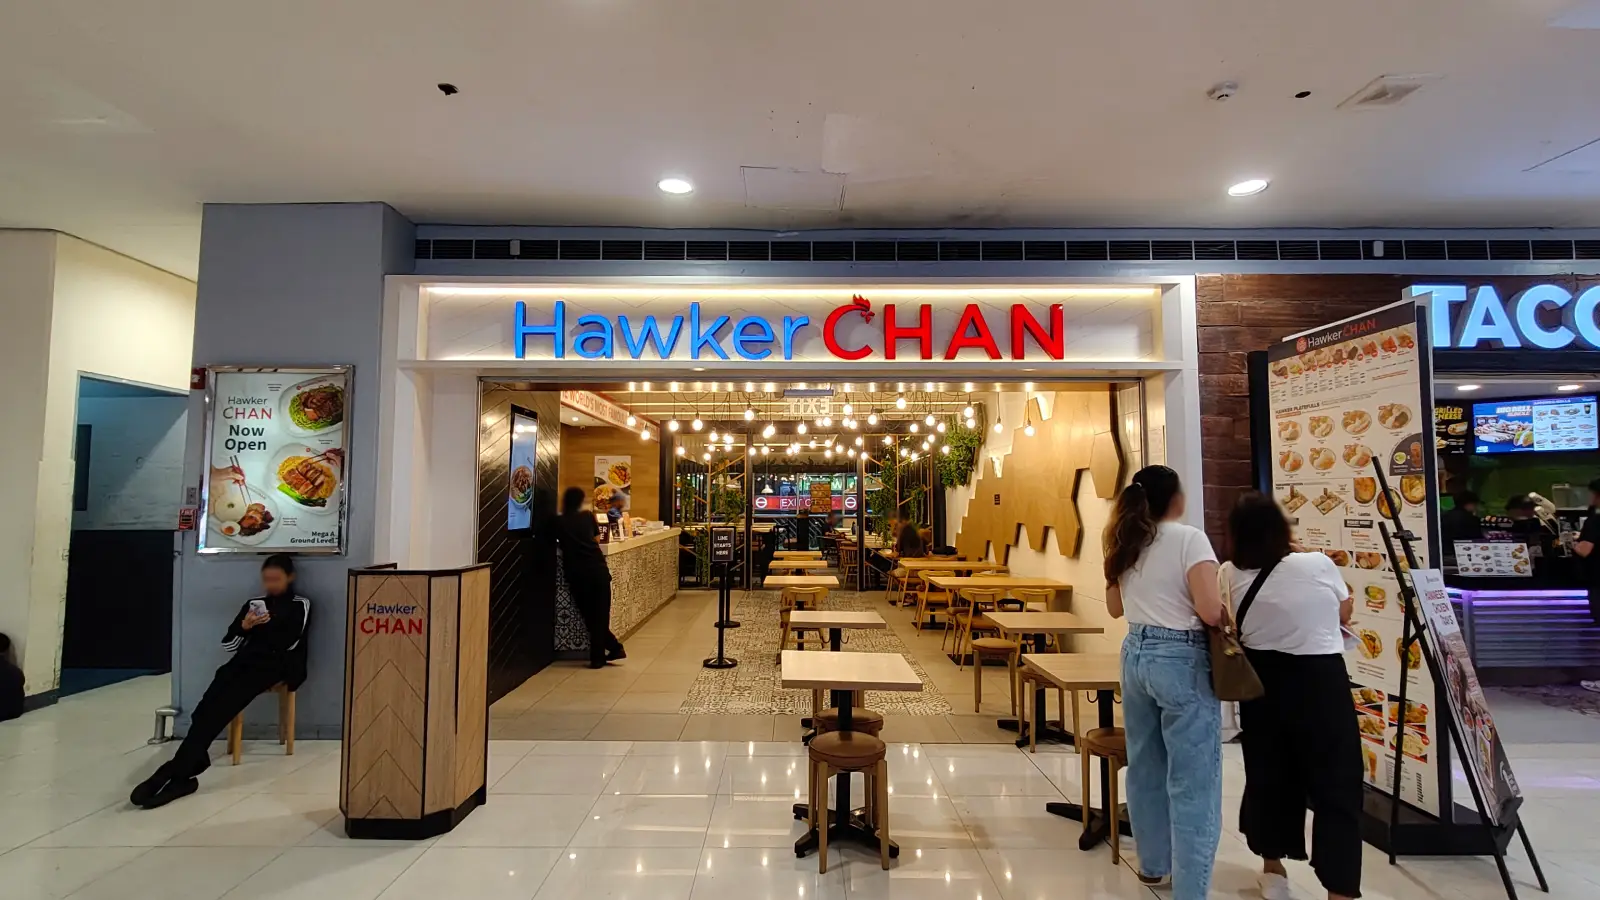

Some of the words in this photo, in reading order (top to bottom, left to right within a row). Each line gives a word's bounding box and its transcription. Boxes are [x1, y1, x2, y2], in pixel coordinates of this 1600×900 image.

[514, 300, 809, 361] Hawker
[822, 295, 1065, 361] CHAN
[1307, 330, 1343, 348] Hawker
[1343, 318, 1376, 337] CHAN
[228, 396, 268, 405] Hawker
[222, 406, 272, 419] CHAN
[229, 424, 264, 436] Now
[224, 438, 267, 453] Open
[781, 498, 802, 507] EXIT
[367, 603, 417, 614] Hawker
[360, 616, 423, 635] CHAN
